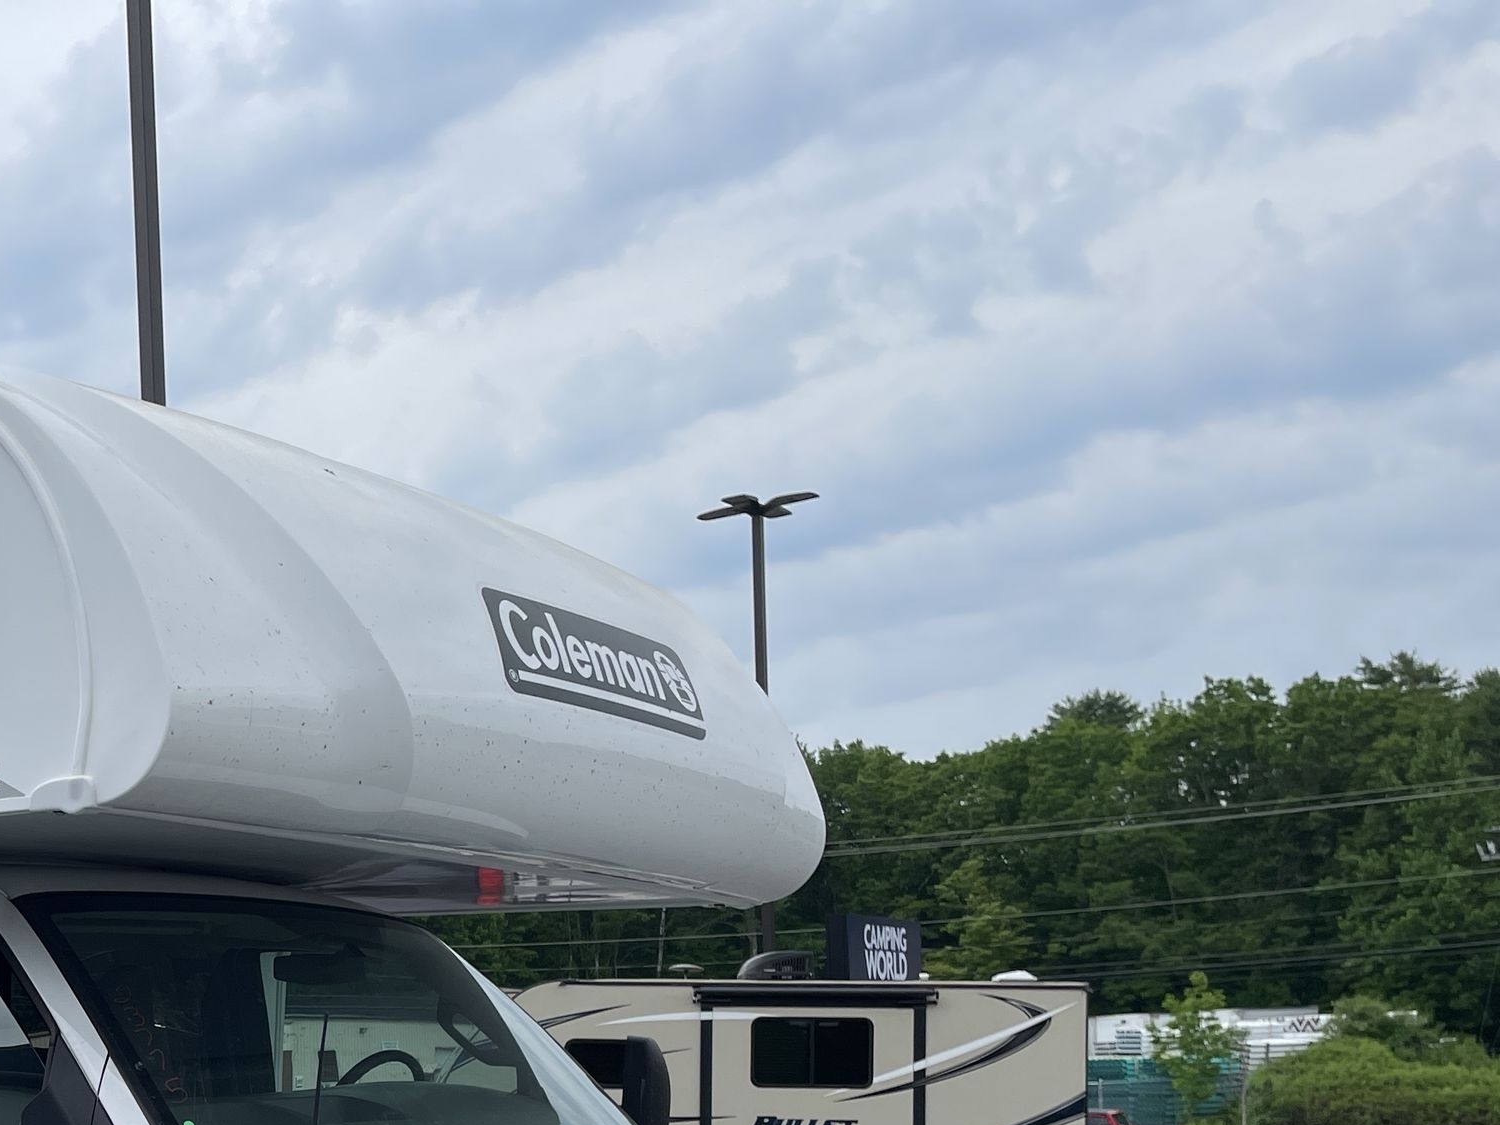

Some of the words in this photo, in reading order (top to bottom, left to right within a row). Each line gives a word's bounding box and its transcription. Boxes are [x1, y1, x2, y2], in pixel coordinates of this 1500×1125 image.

[498, 598, 667, 702] Coleman
[863, 923, 908, 953] CAMPING
[864, 949, 908, 981] WORLD
